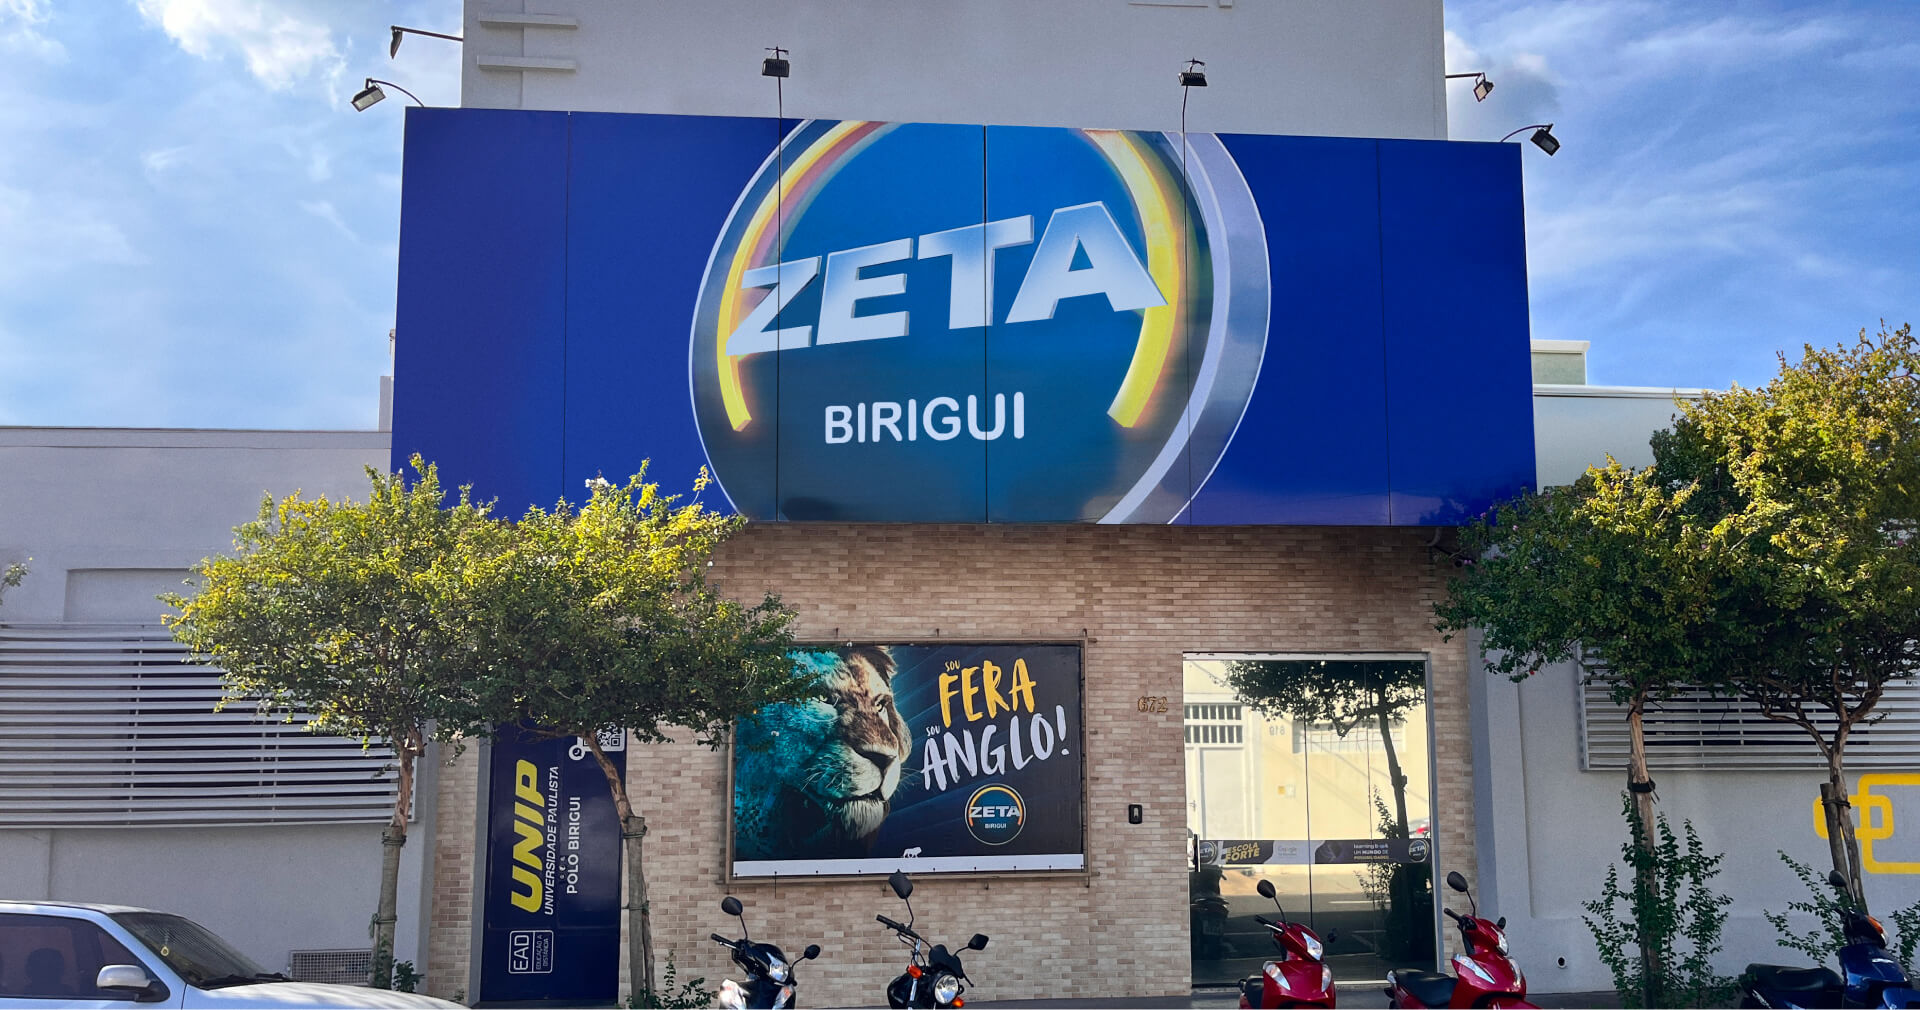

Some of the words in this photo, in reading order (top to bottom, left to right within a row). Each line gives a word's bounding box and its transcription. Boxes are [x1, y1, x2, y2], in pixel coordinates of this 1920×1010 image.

[725, 200, 1169, 356] ZETA
[825, 391, 1025, 444] BIRIGUI
[944, 659, 961, 672] SOU
[938, 657, 1037, 728] FERA
[1137, 695, 1169, 713] 672
[920, 704, 1070, 791] ANGLO!
[926, 725, 941, 736] SOU
[547, 766, 560, 823] PAULISTA
[968, 805, 1021, 819] ZETA
[511, 759, 545, 913] UNIP
[567, 796, 581, 850] BIRIGUI
[544, 825, 558, 915] UNIVERSIDADE
[1224, 847, 1261, 862] FORTE
[1226, 841, 1259, 854] ESCOLA
[566, 854, 579, 894] POLO
[513, 934, 530, 971] EAD
